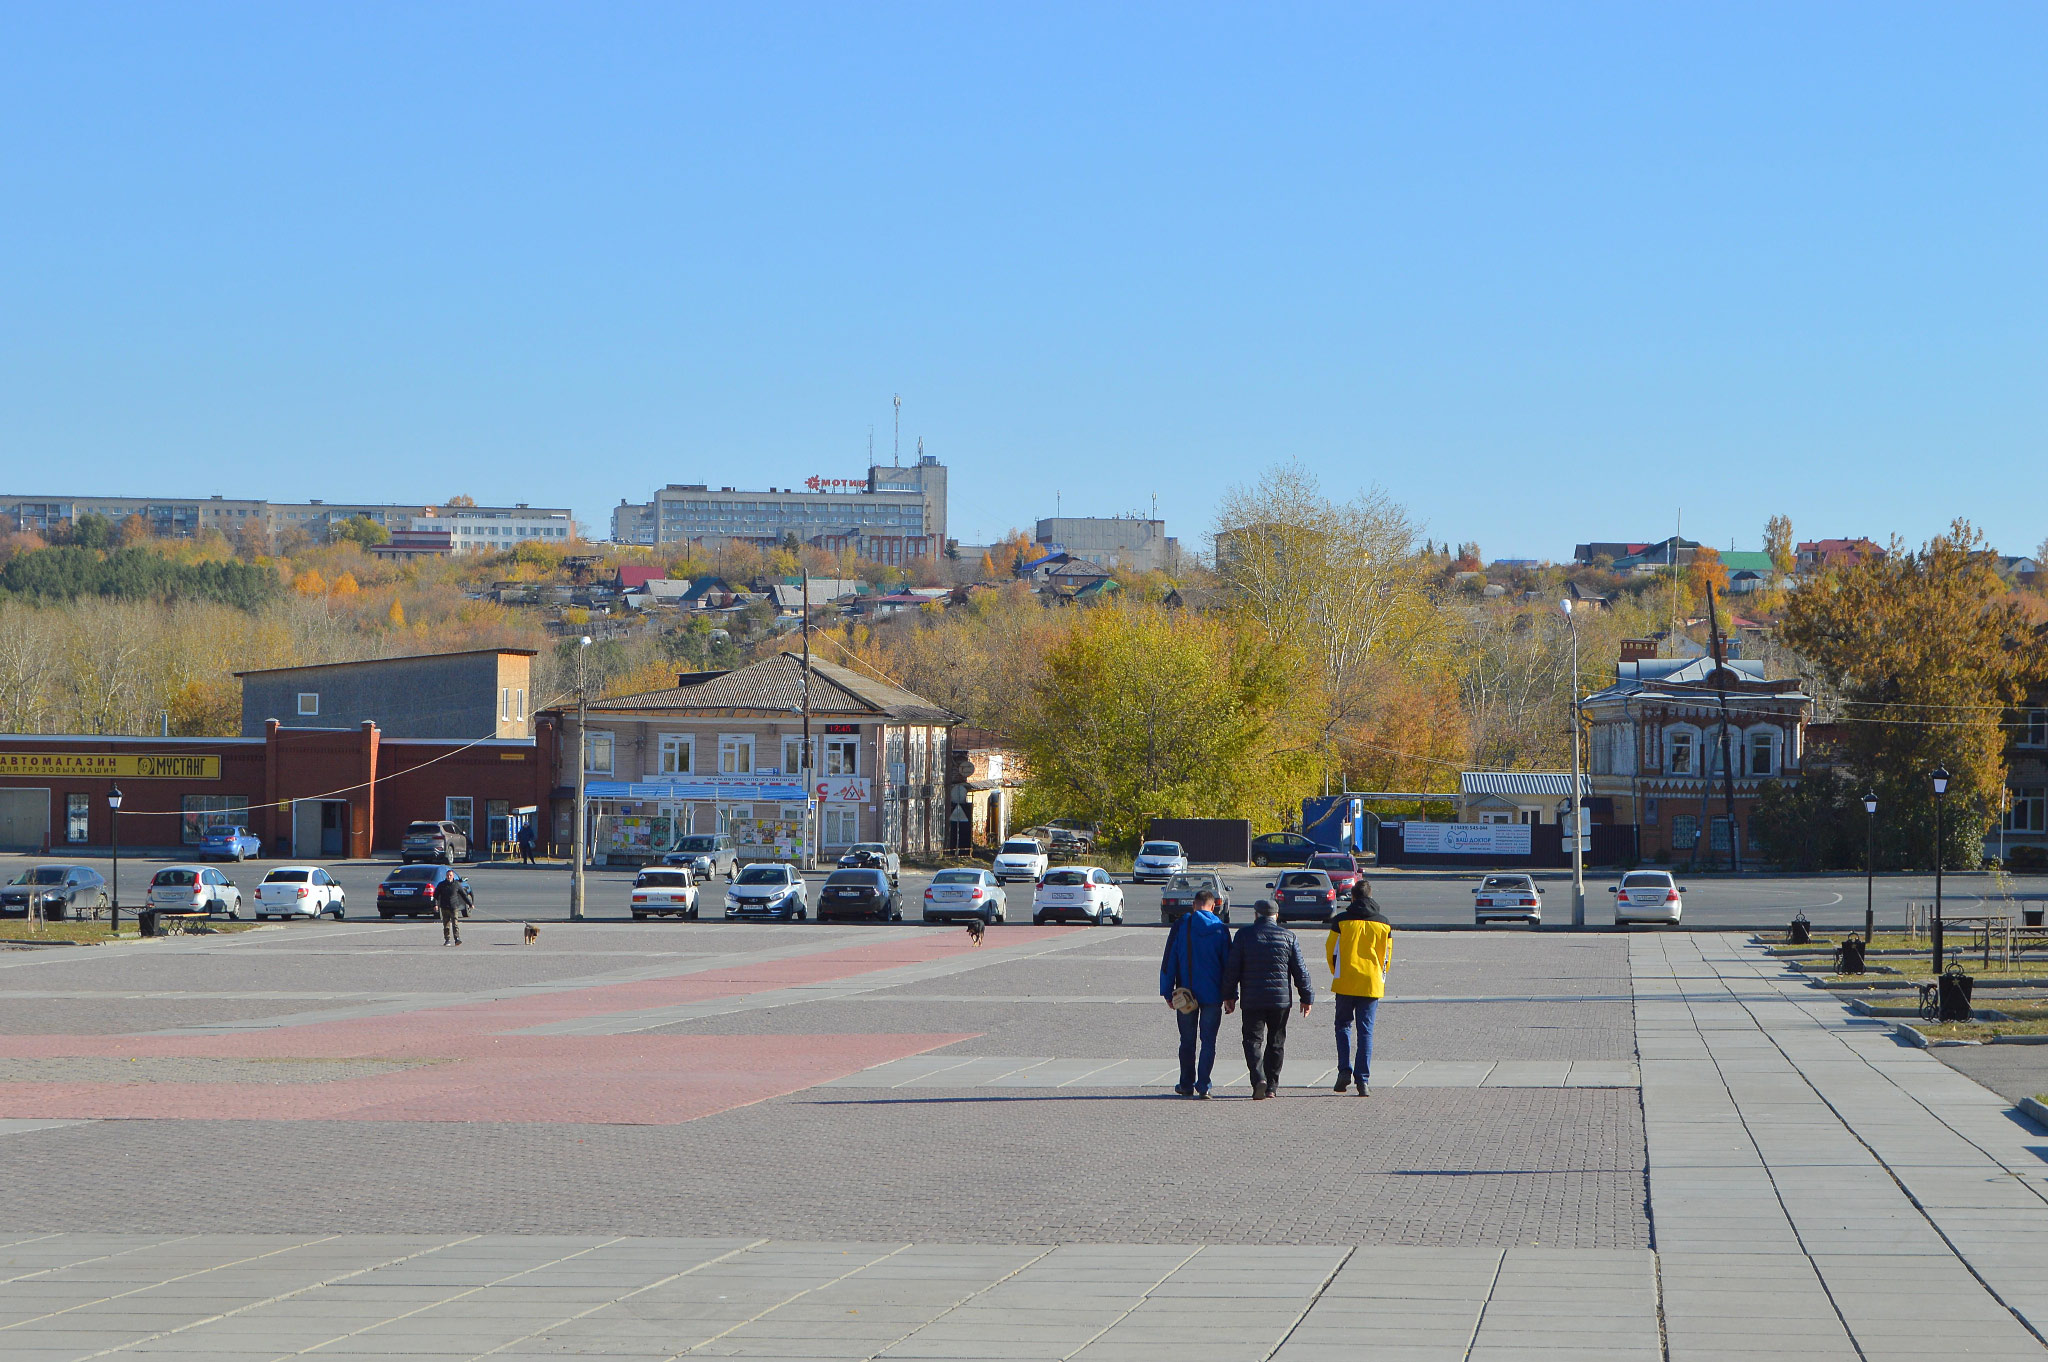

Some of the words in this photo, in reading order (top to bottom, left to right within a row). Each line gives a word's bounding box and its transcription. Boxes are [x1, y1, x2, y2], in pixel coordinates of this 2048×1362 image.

[821, 479, 867, 487] МОТИВ
[0, 756, 117, 767] АВТОМАГАЗИН
[156, 757, 206, 775] МУСТАНГ
